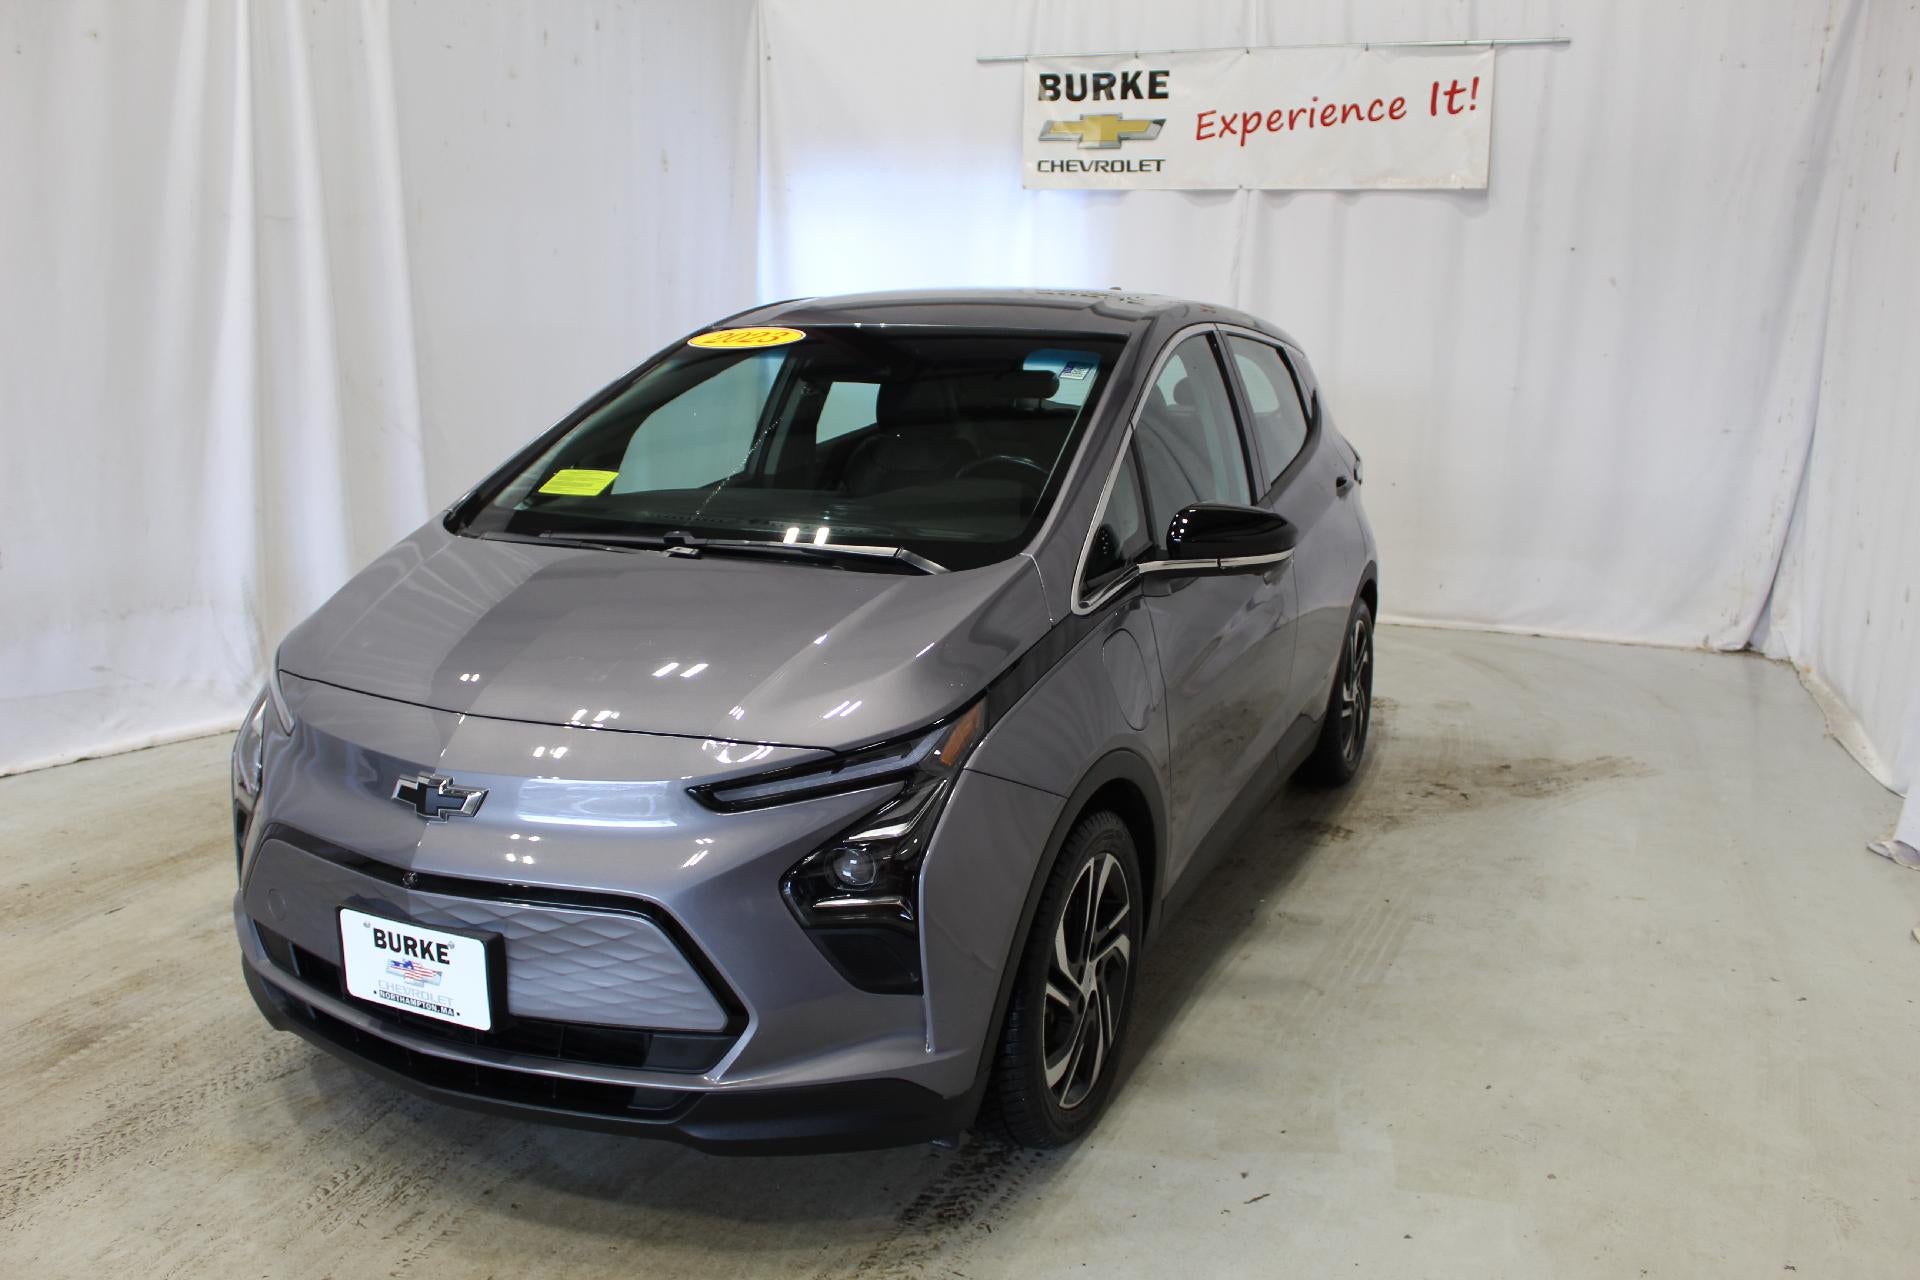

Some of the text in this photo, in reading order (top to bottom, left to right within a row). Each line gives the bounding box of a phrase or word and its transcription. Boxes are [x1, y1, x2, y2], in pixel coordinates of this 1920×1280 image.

[1038, 70, 1169, 101] BURKE
[1195, 76, 1480, 146] Experience It!
[1036, 158, 1166, 173] CHEVROLET
[373, 928, 450, 965] BURKE
[378, 979, 453, 1006] CHEVROLET
